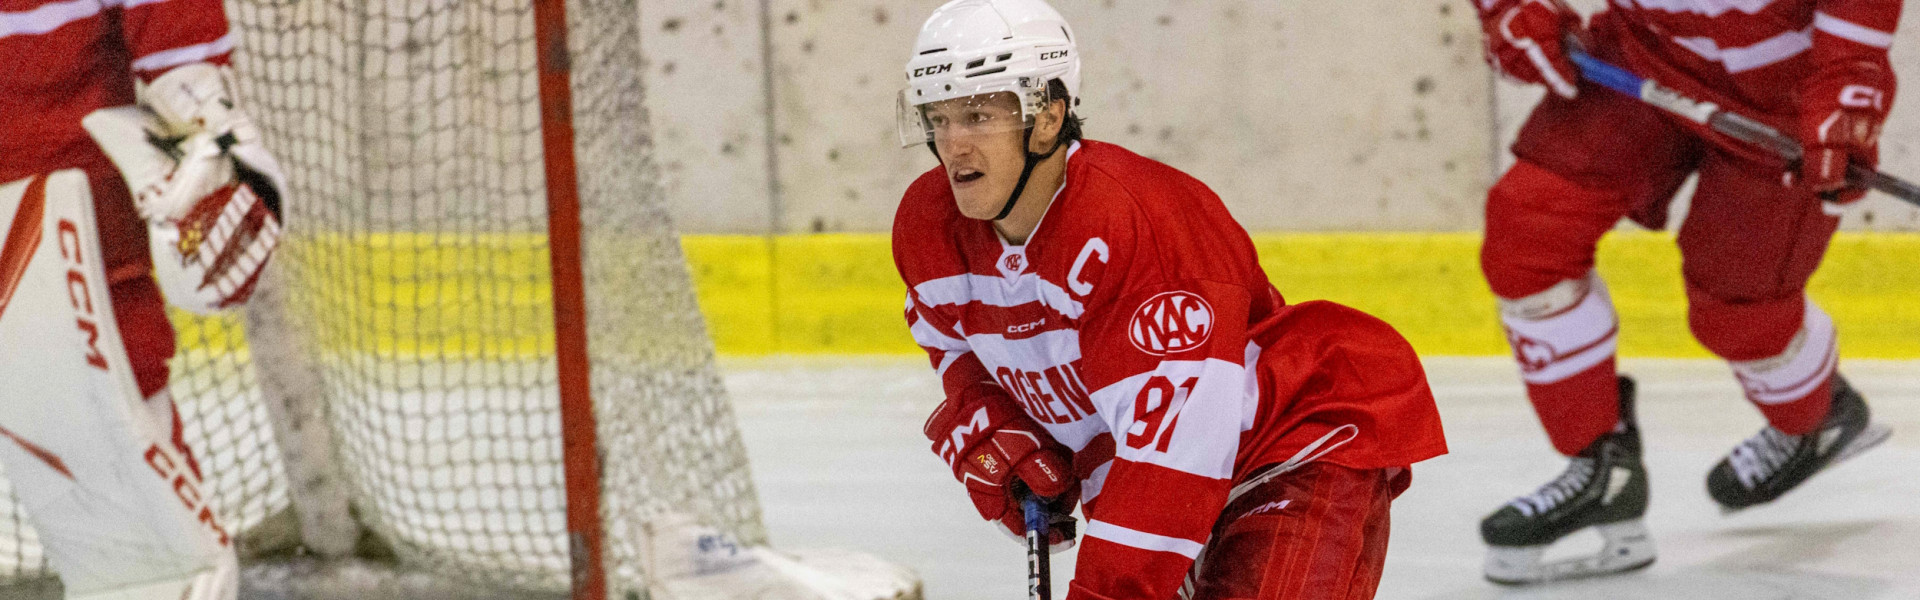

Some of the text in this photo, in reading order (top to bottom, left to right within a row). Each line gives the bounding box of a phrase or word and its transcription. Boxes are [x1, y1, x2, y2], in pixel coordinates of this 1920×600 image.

[914, 63, 953, 77] CCM
[1040, 50, 1068, 61] CCM
[57, 219, 109, 371] CCM
[1067, 237, 1109, 296] C
[1007, 318, 1046, 333] CCM
[1135, 294, 1206, 352] KAC
[1126, 376, 1199, 453] 91
[143, 443, 229, 547] CCM
[1034, 458, 1058, 483] CCM
